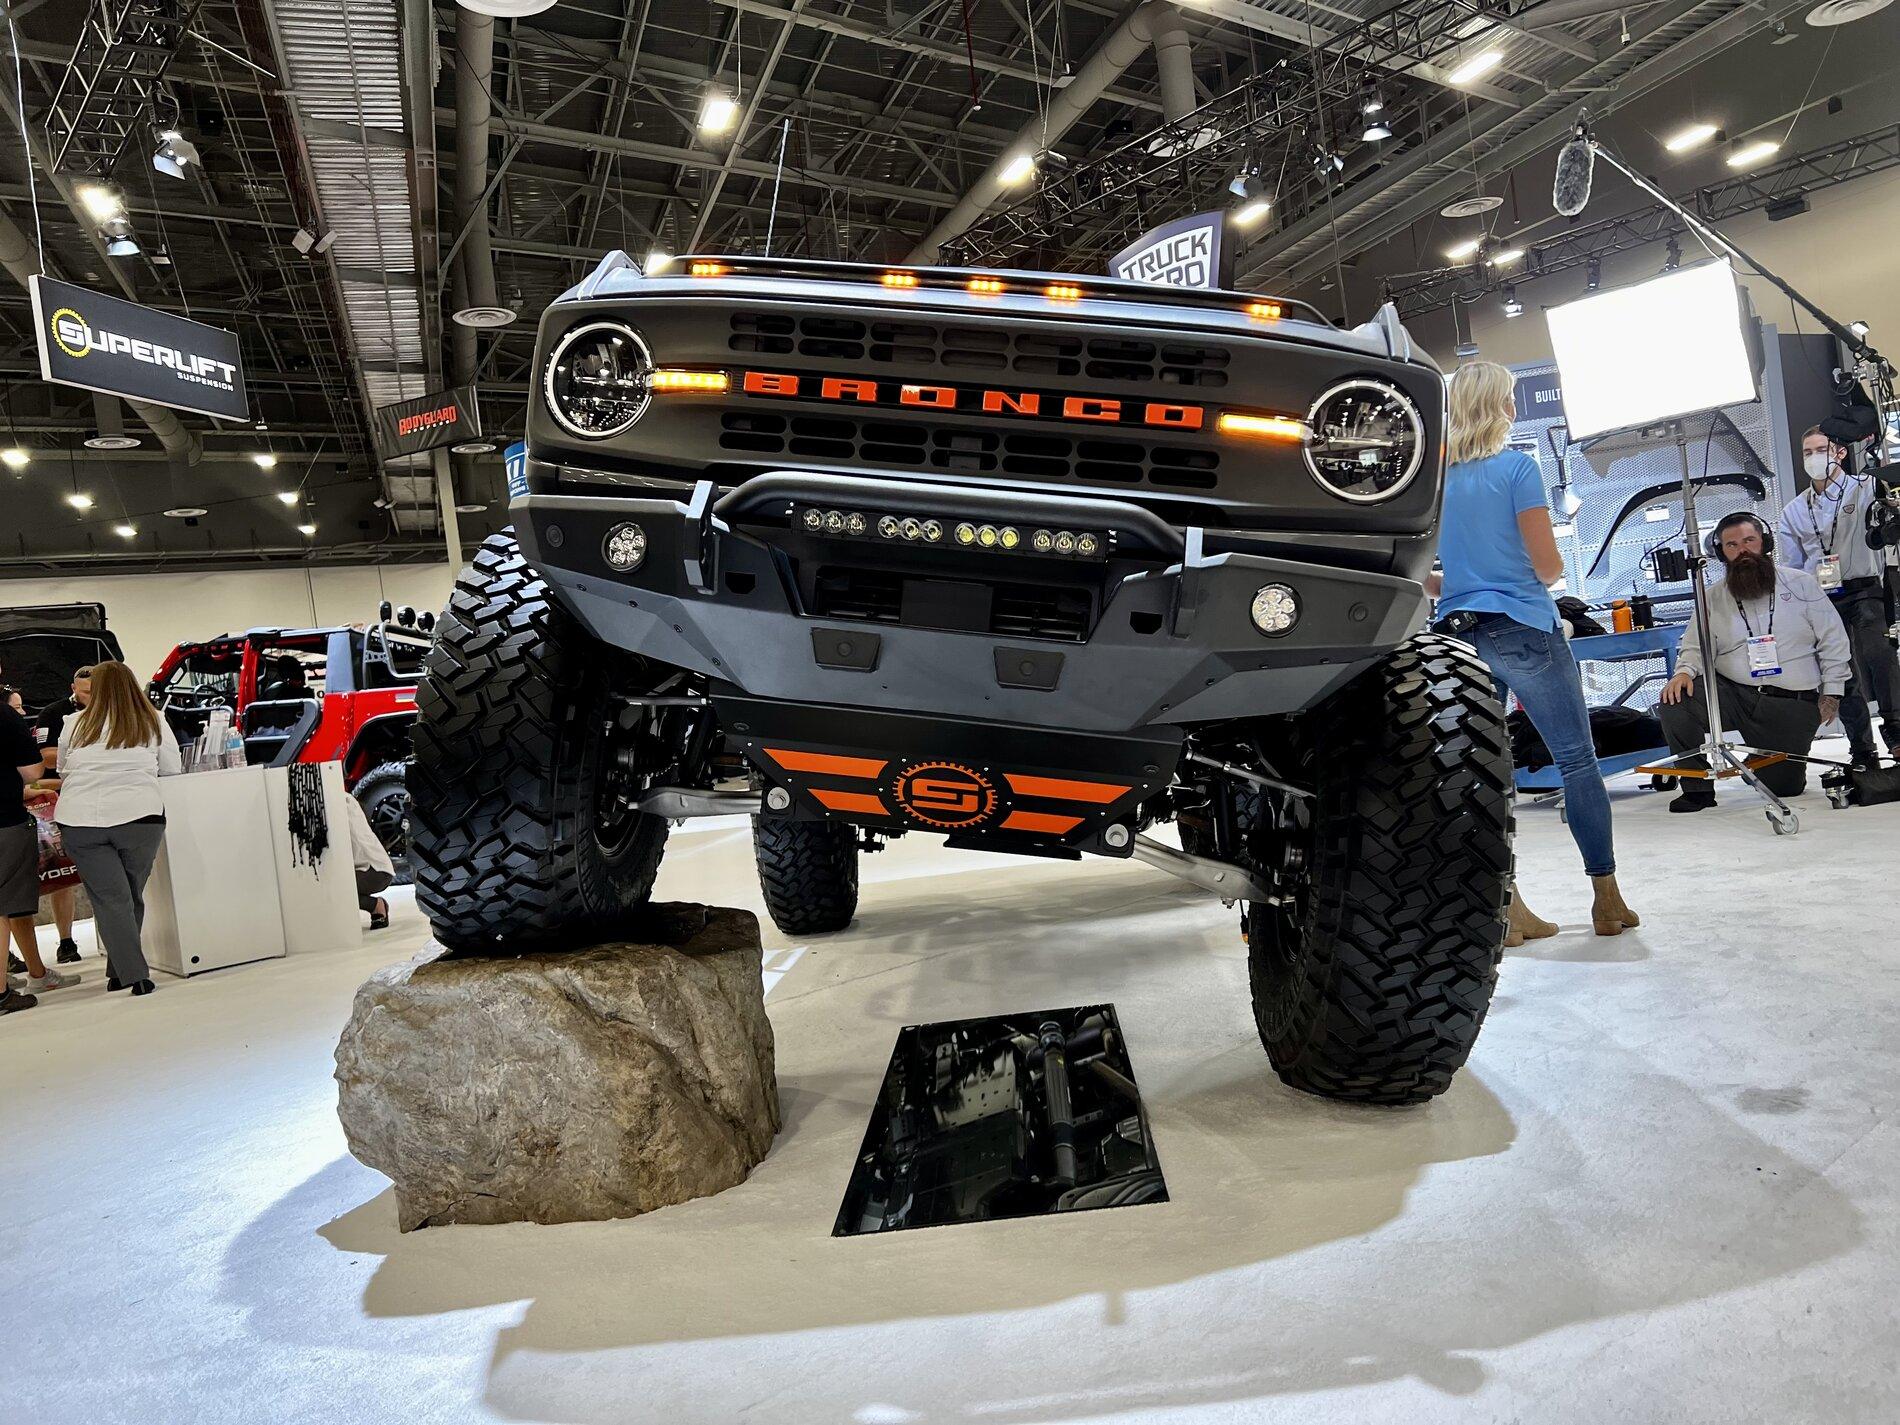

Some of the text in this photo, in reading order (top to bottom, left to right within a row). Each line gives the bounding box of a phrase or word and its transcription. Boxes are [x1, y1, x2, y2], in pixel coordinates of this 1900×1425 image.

[1122, 231, 1208, 280] TRUCK
[1150, 261, 1206, 288] RO
[58, 319, 236, 383] SUPERLIFT
[177, 371, 234, 392] SUSPENSION
[1535, 388, 1561, 404] BUILT
[743, 370, 1204, 430] BRONCO
[398, 405, 457, 436] BODYGUARD
